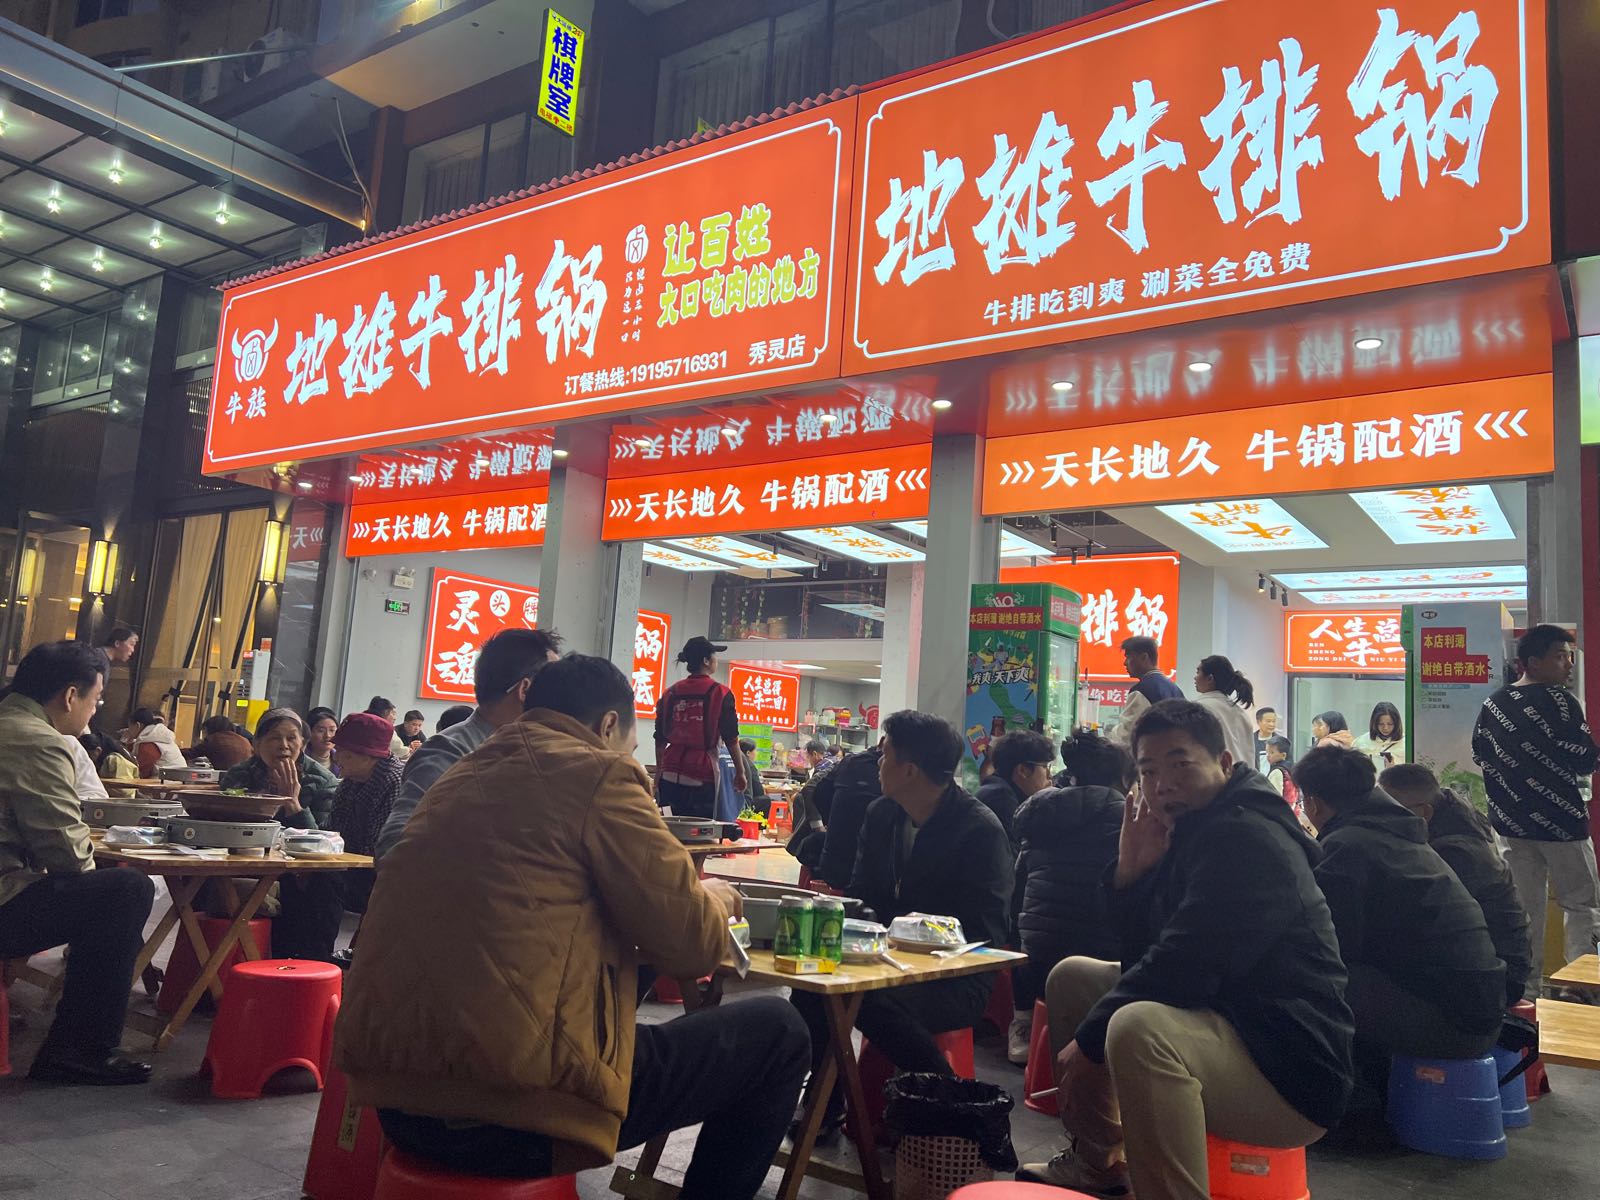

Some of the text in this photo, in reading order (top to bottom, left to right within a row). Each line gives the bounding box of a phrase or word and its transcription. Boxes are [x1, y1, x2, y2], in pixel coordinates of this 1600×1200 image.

[545, 26, 578, 121] 棋牌室
[875, 8, 1499, 286] 地摊牛排锅
[662, 202, 771, 277] 让百姓
[657, 247, 820, 328] 大口吃肉的地方
[984, 242, 1311, 327] 牛排吃到爽 涮菜全免费
[282, 239, 607, 405] 地摊牛排锅
[749, 333, 806, 366] 秀灵店
[225, 385, 267, 424] 牛族
[1041, 411, 1464, 490] 天长地久 牛锅配酒
[371, 503, 547, 543] 天长地久 牛锅配酒
[634, 467, 890, 522] 天长地久 牛锅配酒
[1080, 588, 1169, 647] 排锅
[1424, 634, 1466, 649] 本店利薄
[1422, 661, 1486, 677] 谢绝自带酒水
[1526, 776, 1585, 819] BEATSSEVEN
